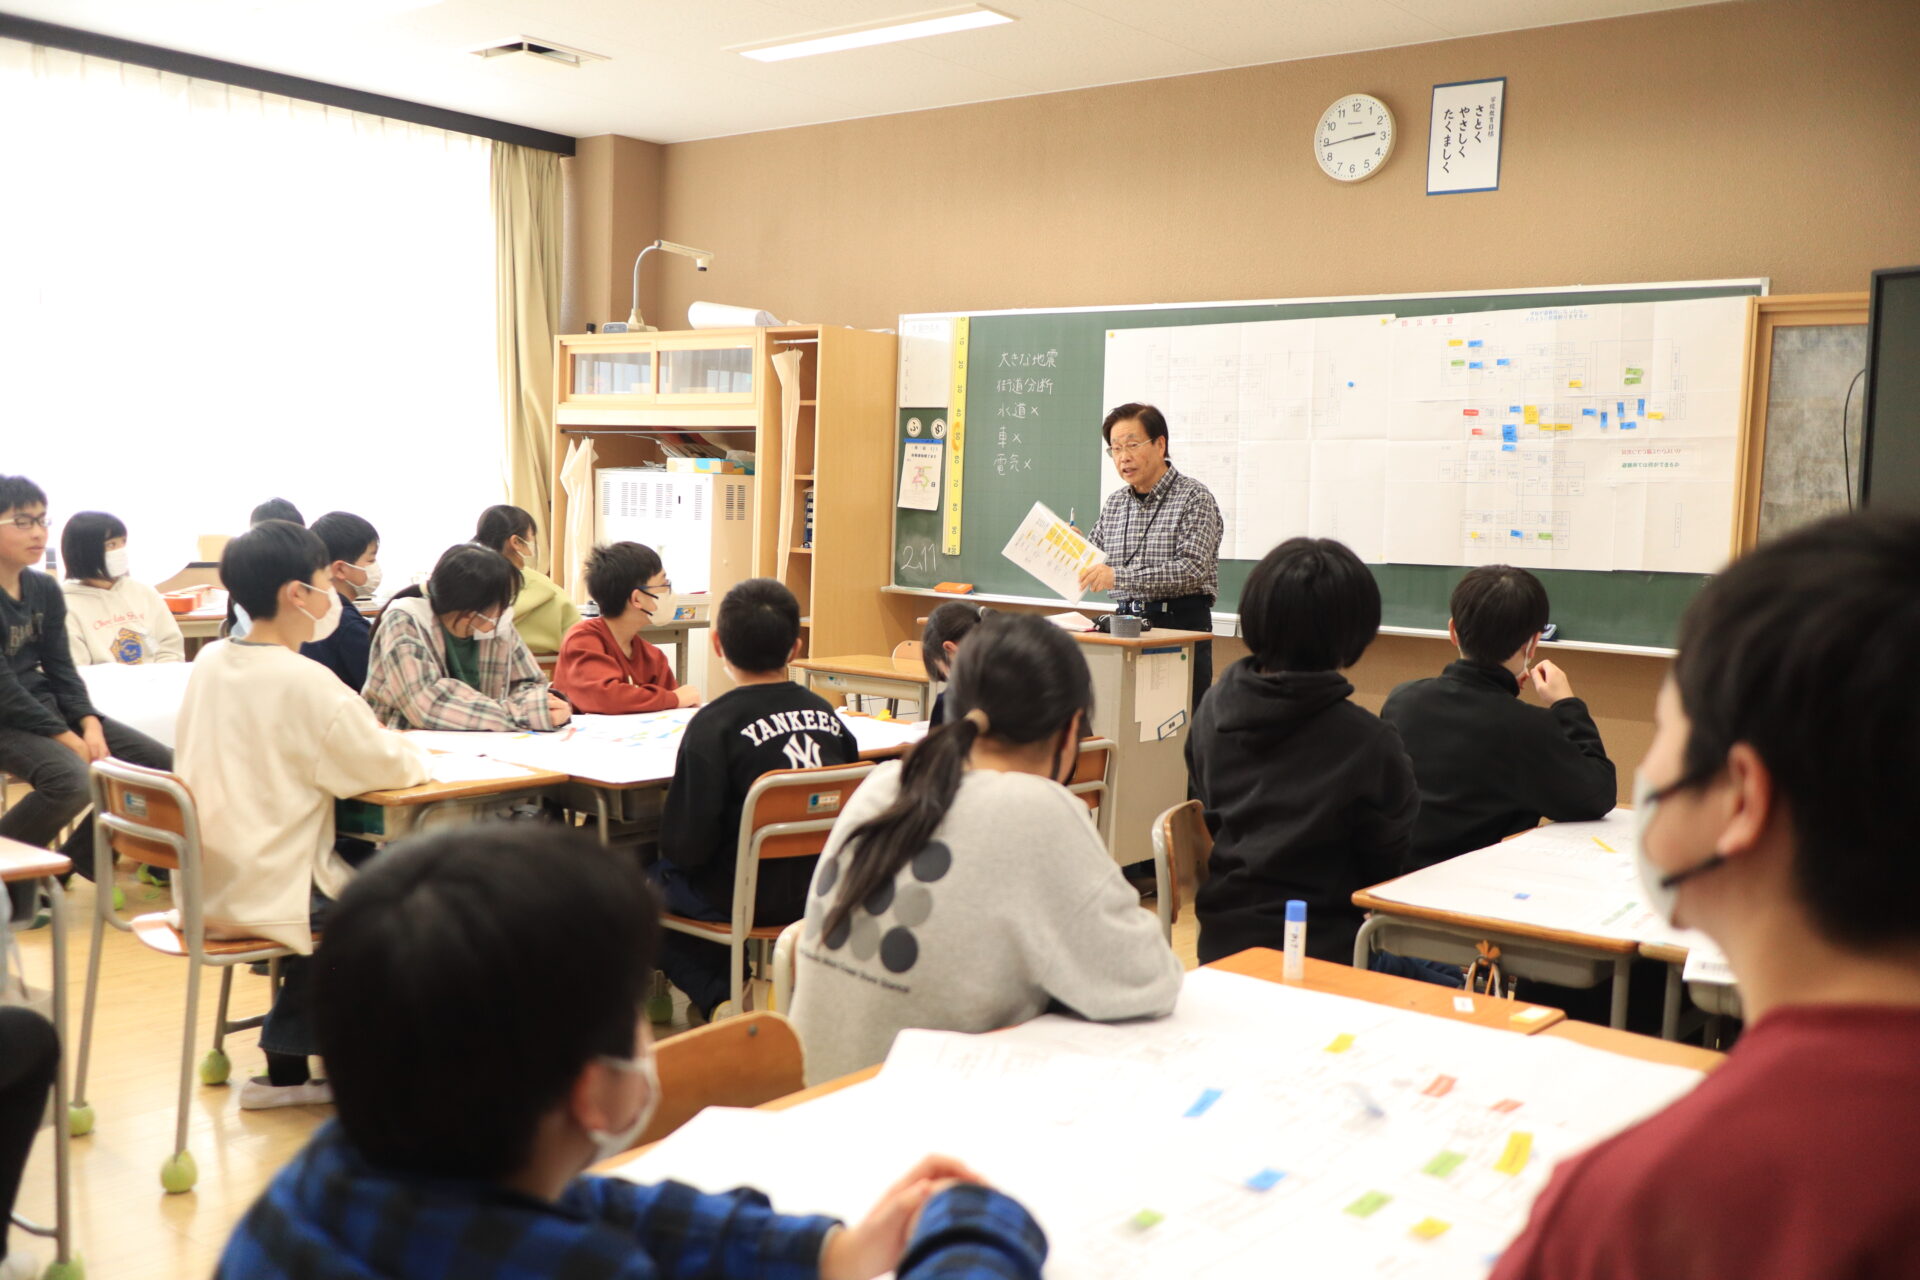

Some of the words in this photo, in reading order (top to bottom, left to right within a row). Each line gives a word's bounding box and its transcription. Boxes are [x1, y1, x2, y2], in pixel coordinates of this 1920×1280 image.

[1351, 103, 1362, 113] 12
[1368, 106, 1374, 115] 1
[1337, 108, 1346, 119] 11
[1376, 115, 1384, 126] 2
[1473, 104, 1485, 144] さとく
[1326, 121, 1337, 132] 10
[1380, 131, 1388, 141] 3
[1457, 106, 1471, 159] やさしく
[1323, 137, 1331, 147] 9
[1442, 108, 1455, 174] たくましく
[1326, 152, 1333, 162] 8
[1374, 147, 1381, 157] 4
[1336, 162, 1343, 172] 7
[1349, 164, 1356, 174] 6
[1363, 159, 1371, 170] 5
[959, 337, 965, 346] 10
[998, 348, 1058, 368] 大きな地震
[958, 361, 964, 369] 20
[957, 385, 963, 394] 30
[997, 377, 1054, 395] 街道分断
[956, 408, 962, 417] 40
[954, 455, 960, 464] 60
[953, 479, 959, 488] 70
[952, 503, 958, 512] 80
[951, 526, 958, 535] 90
[740, 709, 842, 747] YANKEES
